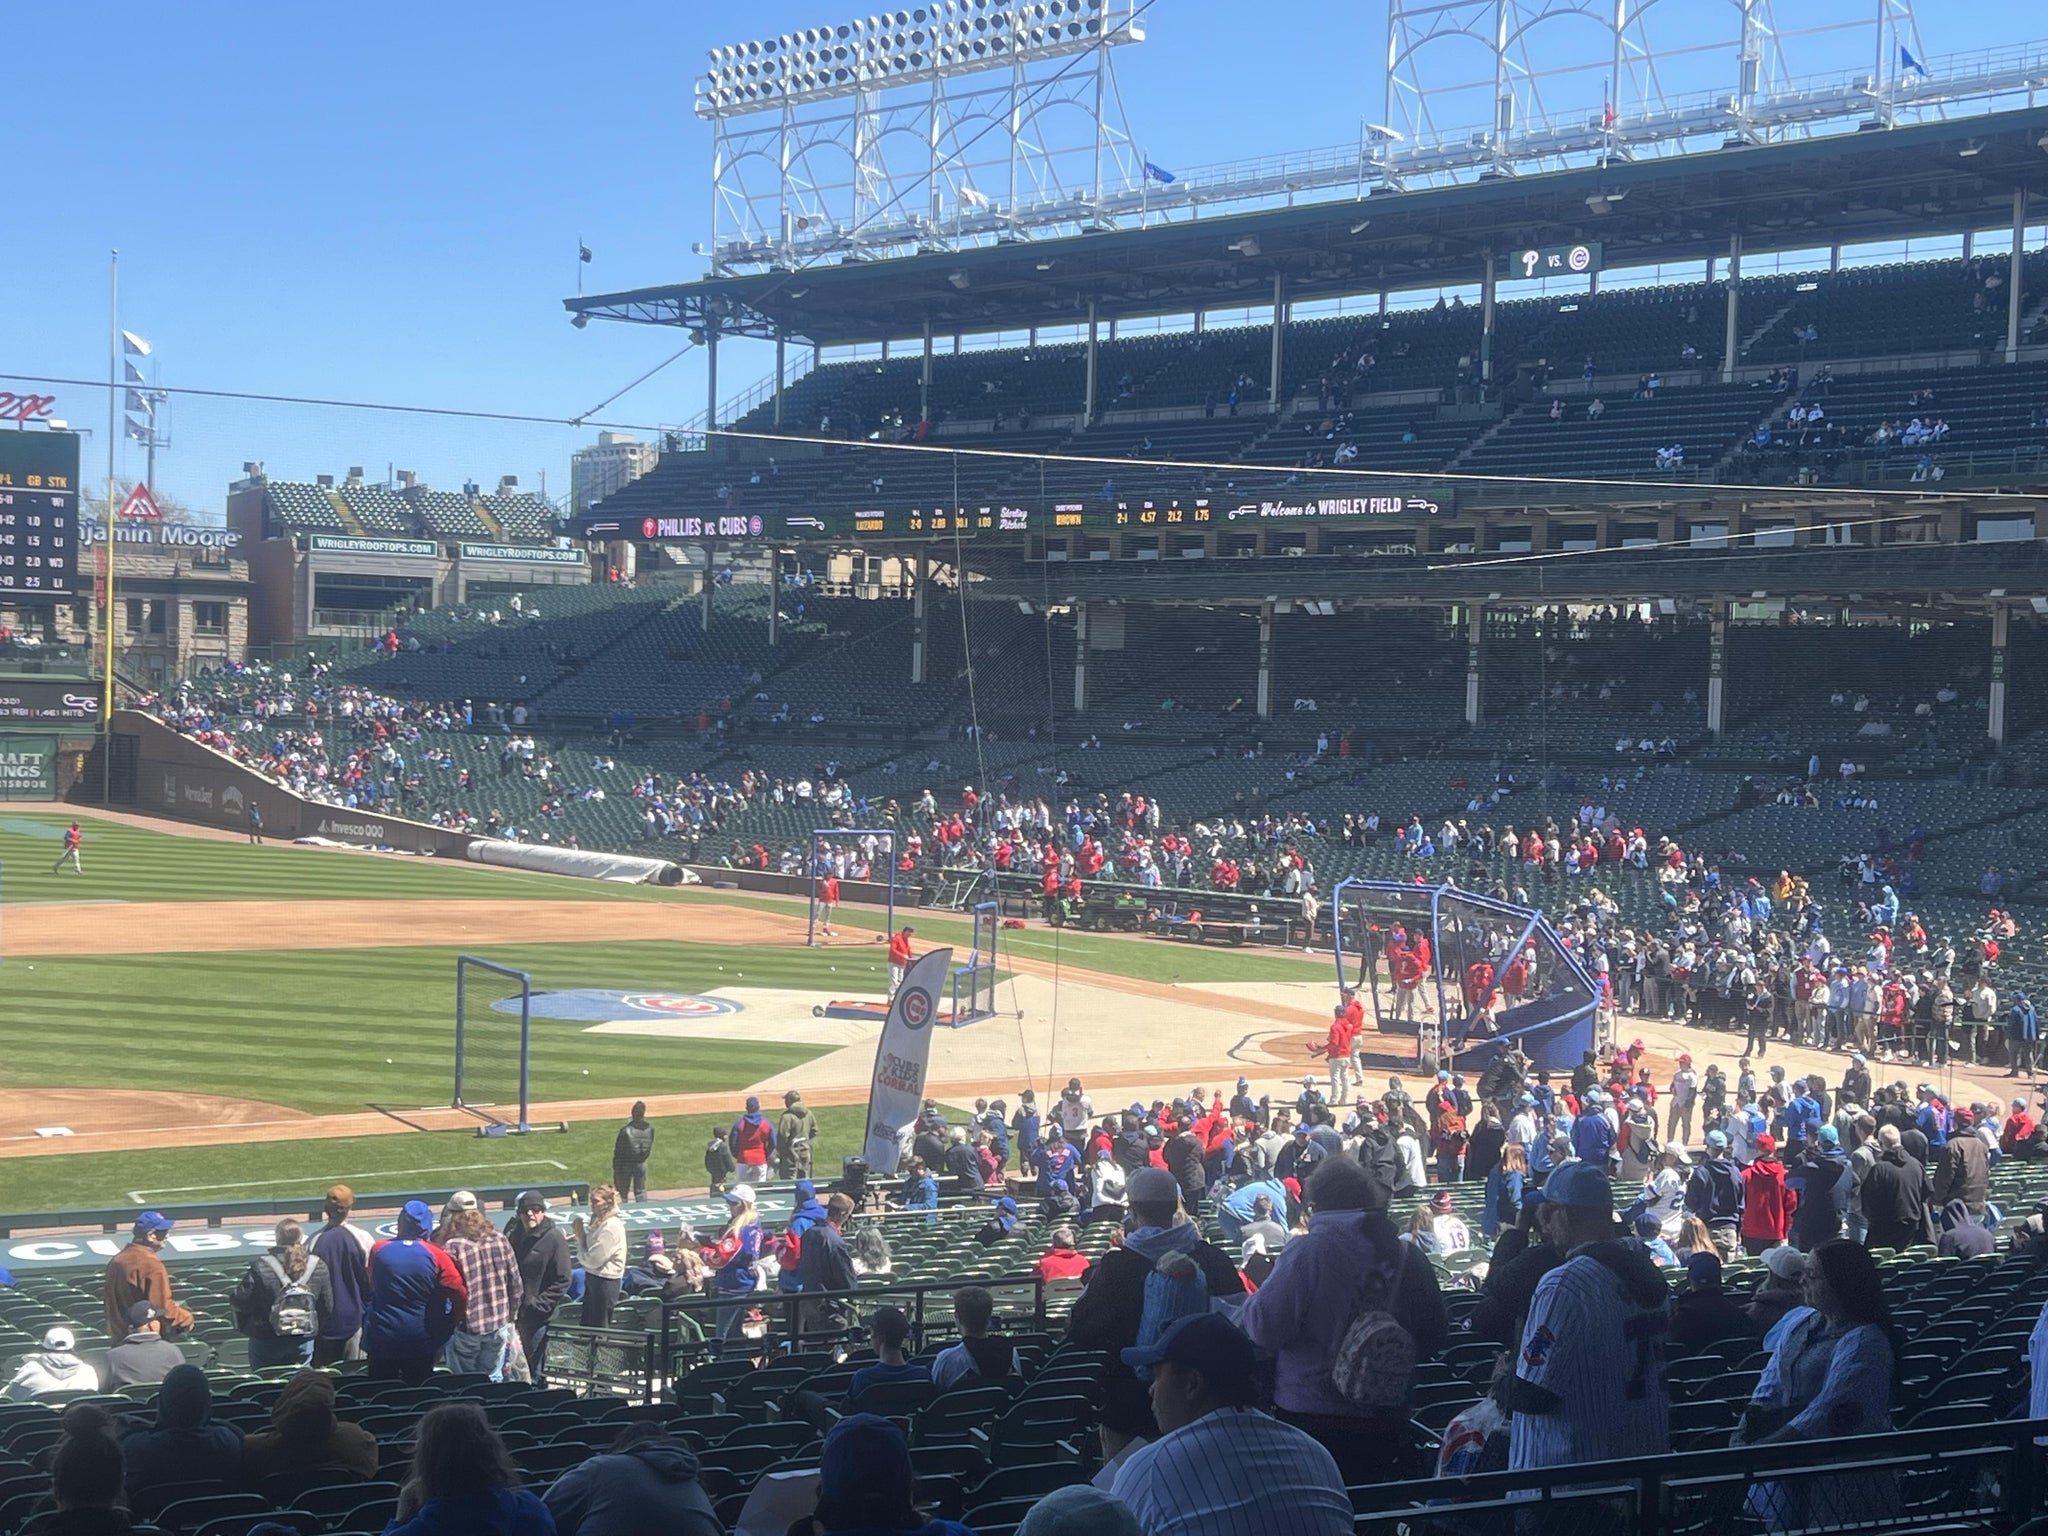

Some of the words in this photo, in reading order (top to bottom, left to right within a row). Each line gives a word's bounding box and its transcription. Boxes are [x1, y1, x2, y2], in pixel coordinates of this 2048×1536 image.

[27, 475, 42, 487] GB
[48, 476, 67, 488] STK
[1260, 501, 1303, 517] Welcome
[1305, 502, 1316, 516] to
[1318, 499, 1367, 515] WRIGLEY
[1370, 497, 1402, 513] FIELD
[658, 518, 701, 537] PHILLIES
[719, 516, 748, 536] CUBS
[161, 525, 238, 547] Moore
[317, 538, 432, 553] WRIGLEYROOFTOPS.COM
[466, 546, 578, 561] WRIGLEYROOFTOPS.COM
[331, 821, 364, 836] Invesco
[1450, 1232, 1466, 1249] 19
